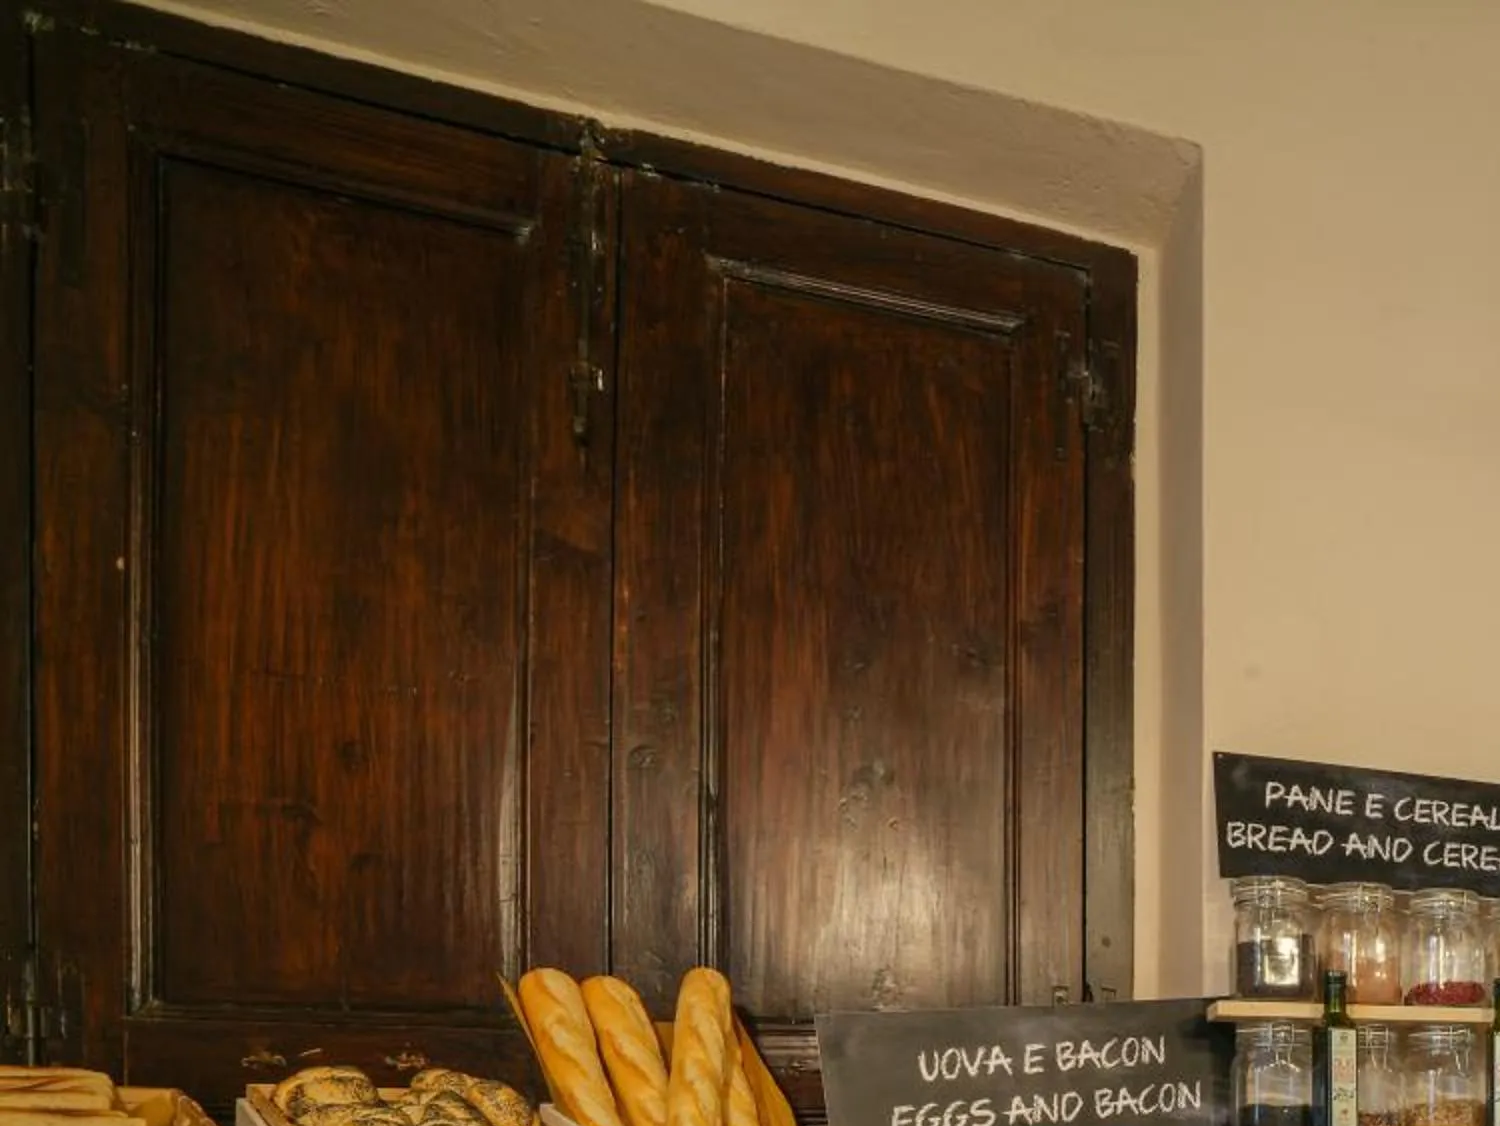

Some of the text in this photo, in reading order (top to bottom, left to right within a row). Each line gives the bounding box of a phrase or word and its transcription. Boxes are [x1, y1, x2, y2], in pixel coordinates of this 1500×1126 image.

[1265, 781, 1354, 816] PANE
[1365, 794, 1384, 819] E
[1226, 822, 1334, 856] BREAD
[1341, 834, 1413, 863] AND
[917, 1035, 1165, 1082] UOVA E BACON
[1003, 1092, 1084, 1126] AND
[1095, 1080, 1201, 1119] BACON
